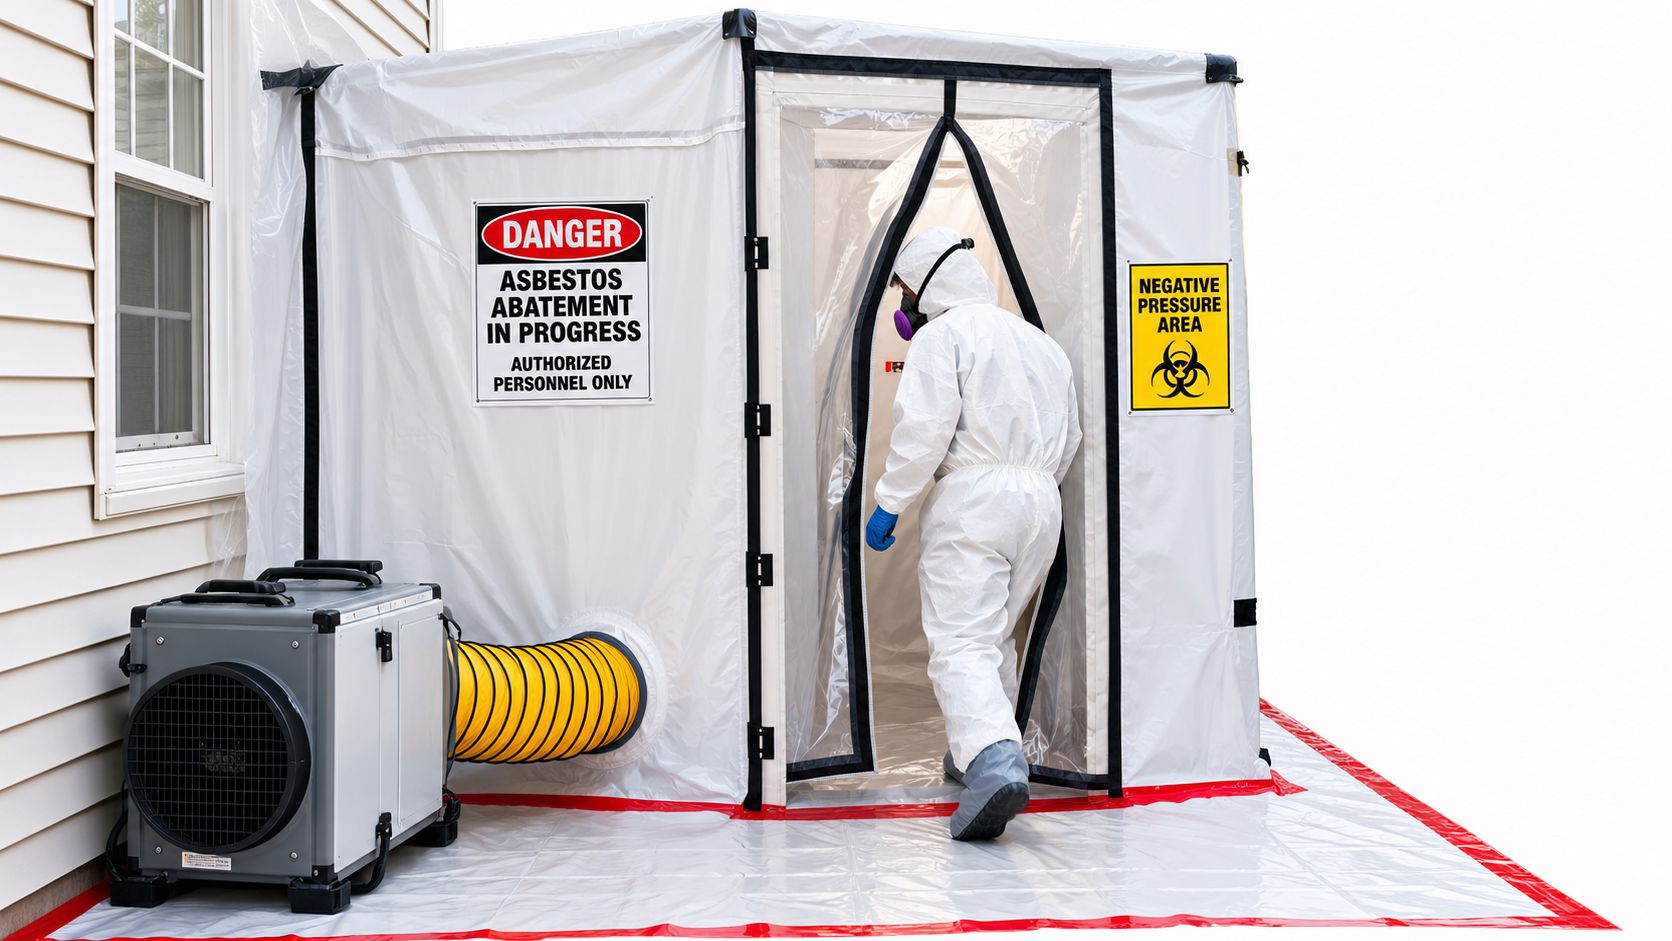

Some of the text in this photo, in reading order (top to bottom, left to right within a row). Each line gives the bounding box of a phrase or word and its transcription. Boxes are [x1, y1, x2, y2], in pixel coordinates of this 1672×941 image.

[502, 218, 623, 249] DANGER
[499, 268, 623, 292] ASBESTOS
[1139, 277, 1220, 294] NEGATIVE
[490, 294, 633, 319] ABATEMENT
[1138, 296, 1221, 314] PRESSURE
[487, 320, 641, 344] IN PROGRESS
[1157, 316, 1203, 333] AREA
[511, 355, 612, 372] AUTHORIZED
[493, 374, 633, 392] PERSONNEL ONLY
